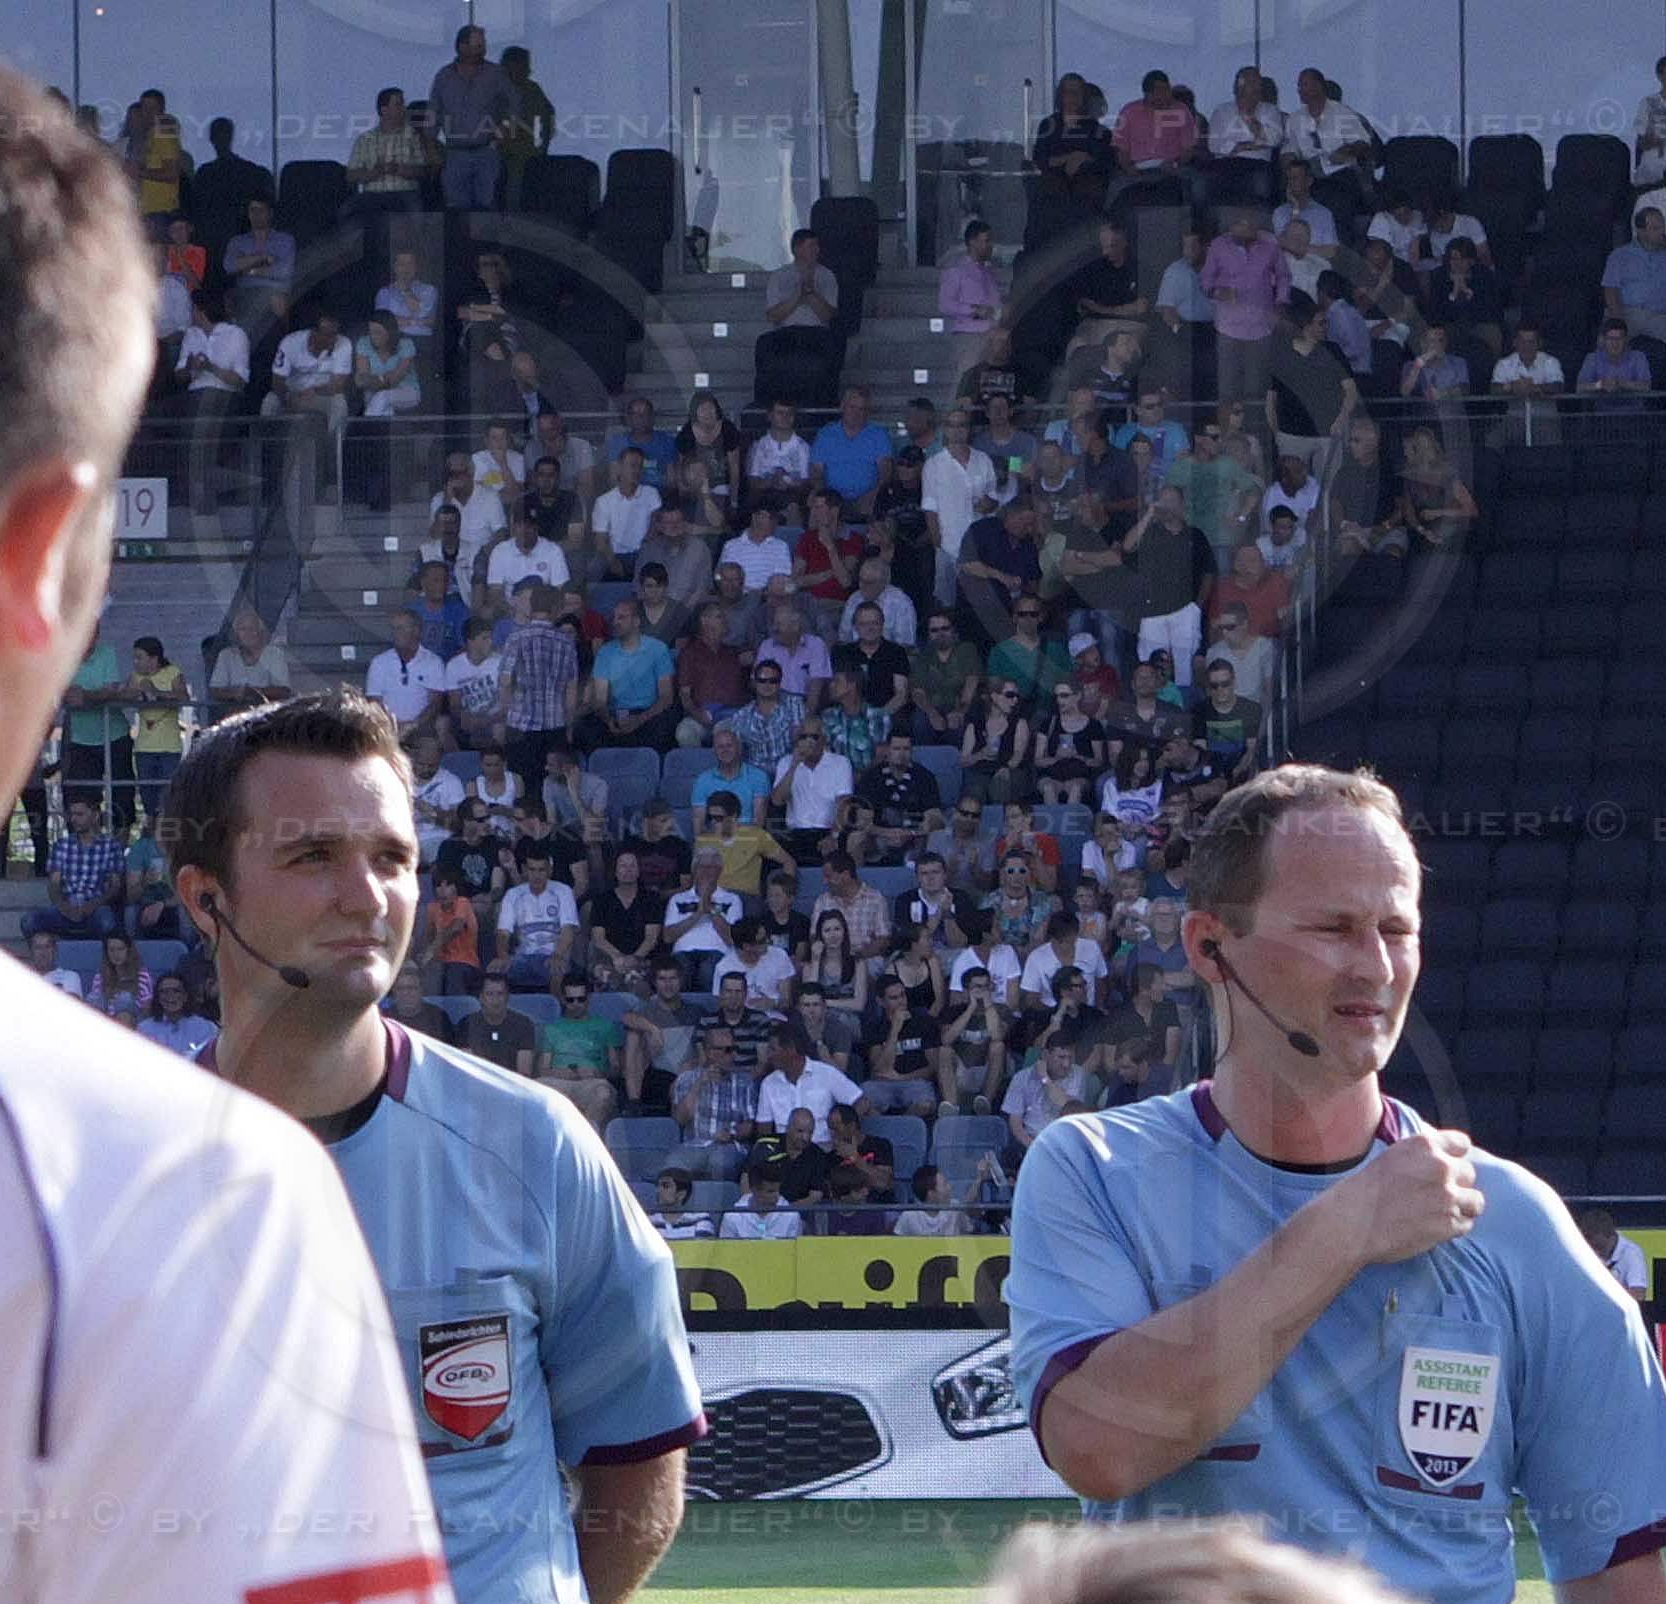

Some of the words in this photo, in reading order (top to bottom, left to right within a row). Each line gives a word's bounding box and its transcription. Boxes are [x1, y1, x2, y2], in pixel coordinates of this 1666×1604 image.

[121, 487, 154, 527] 19
[1412, 1359, 1491, 1378] ASSISTANT
[1416, 1375, 1482, 1394] REFEREE
[1411, 1399, 1480, 1434] FIFA
[1425, 1458, 1459, 1474] 2013
